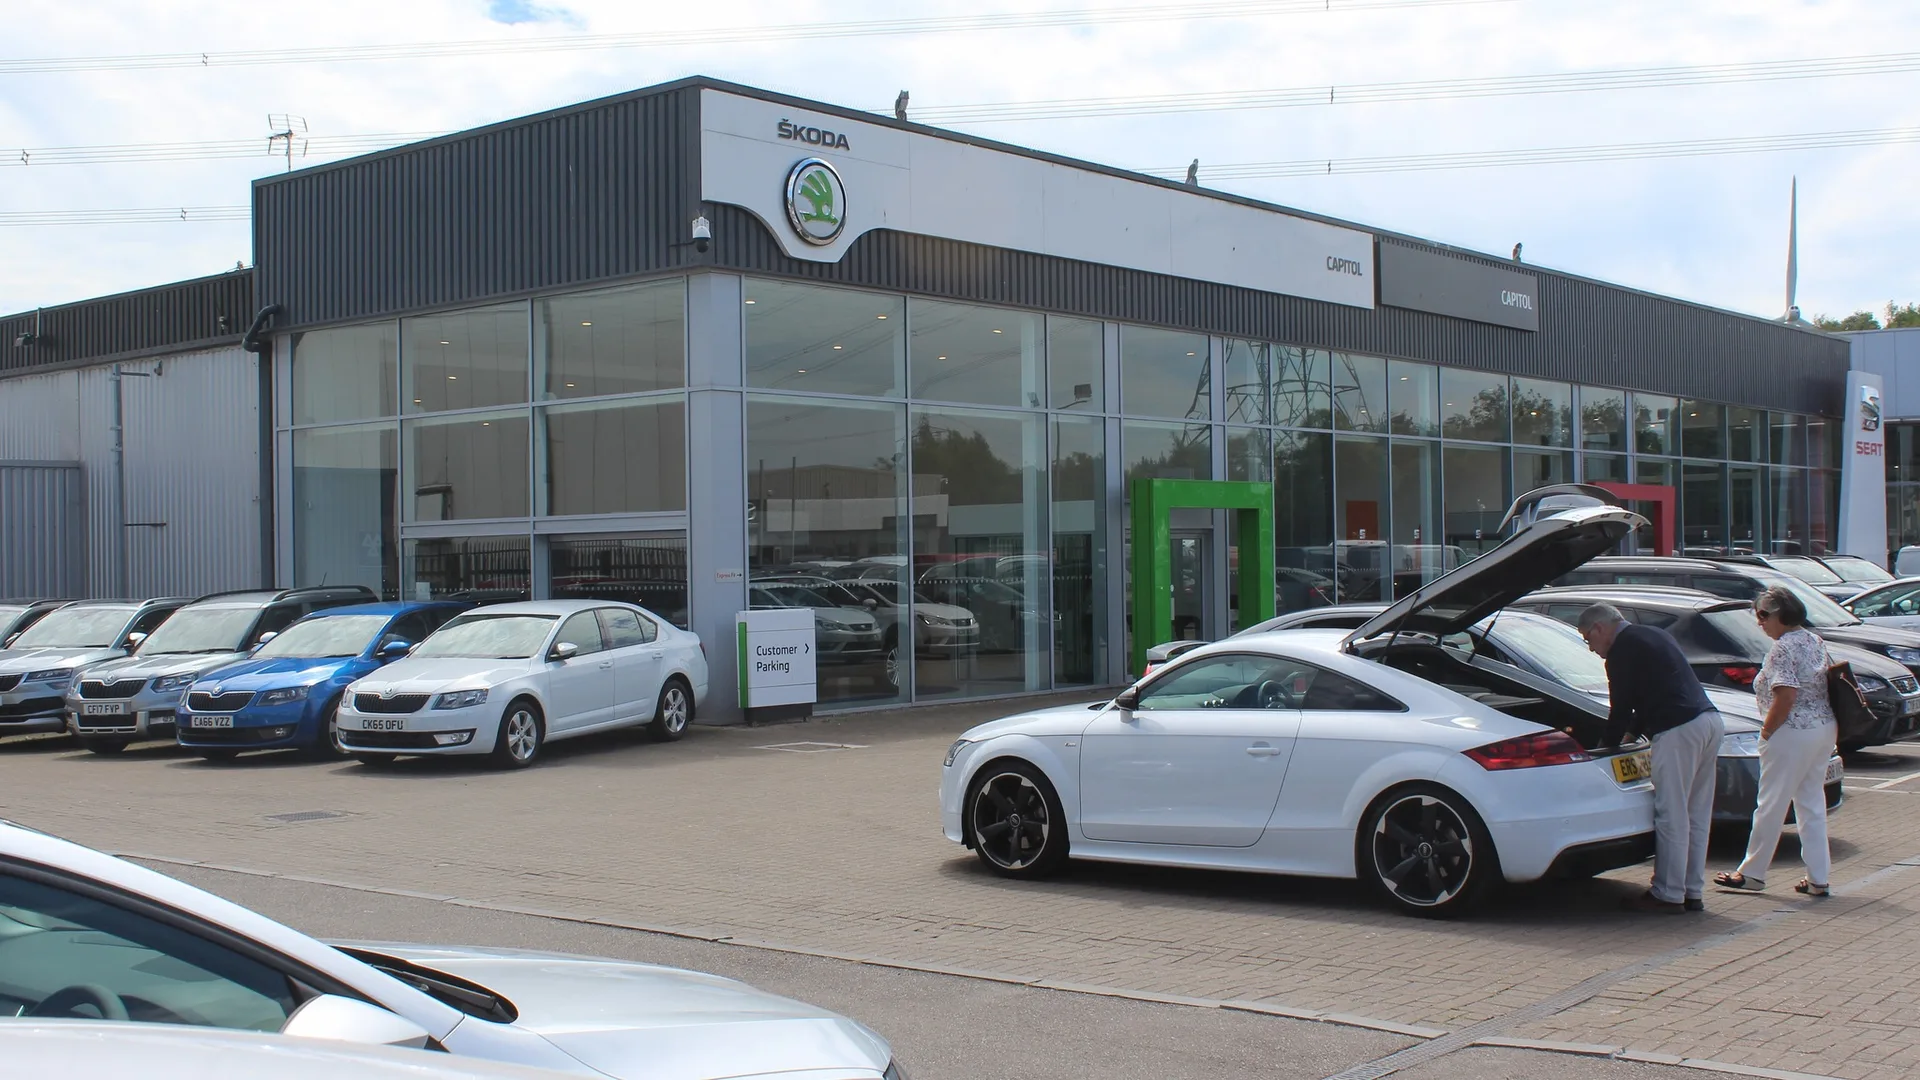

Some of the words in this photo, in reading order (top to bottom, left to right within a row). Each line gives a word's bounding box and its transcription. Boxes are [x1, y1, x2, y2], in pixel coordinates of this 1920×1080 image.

[777, 118, 850, 151] ŠKODA
[1326, 256, 1363, 276] CAPITOL
[1501, 290, 1532, 310] CAPITOL
[1856, 441, 1883, 456] SEAT
[756, 645, 798, 656] Customer
[756, 660, 790, 674] Parking
[194, 716, 213, 727] CA66
[362, 719, 384, 730] CK65
